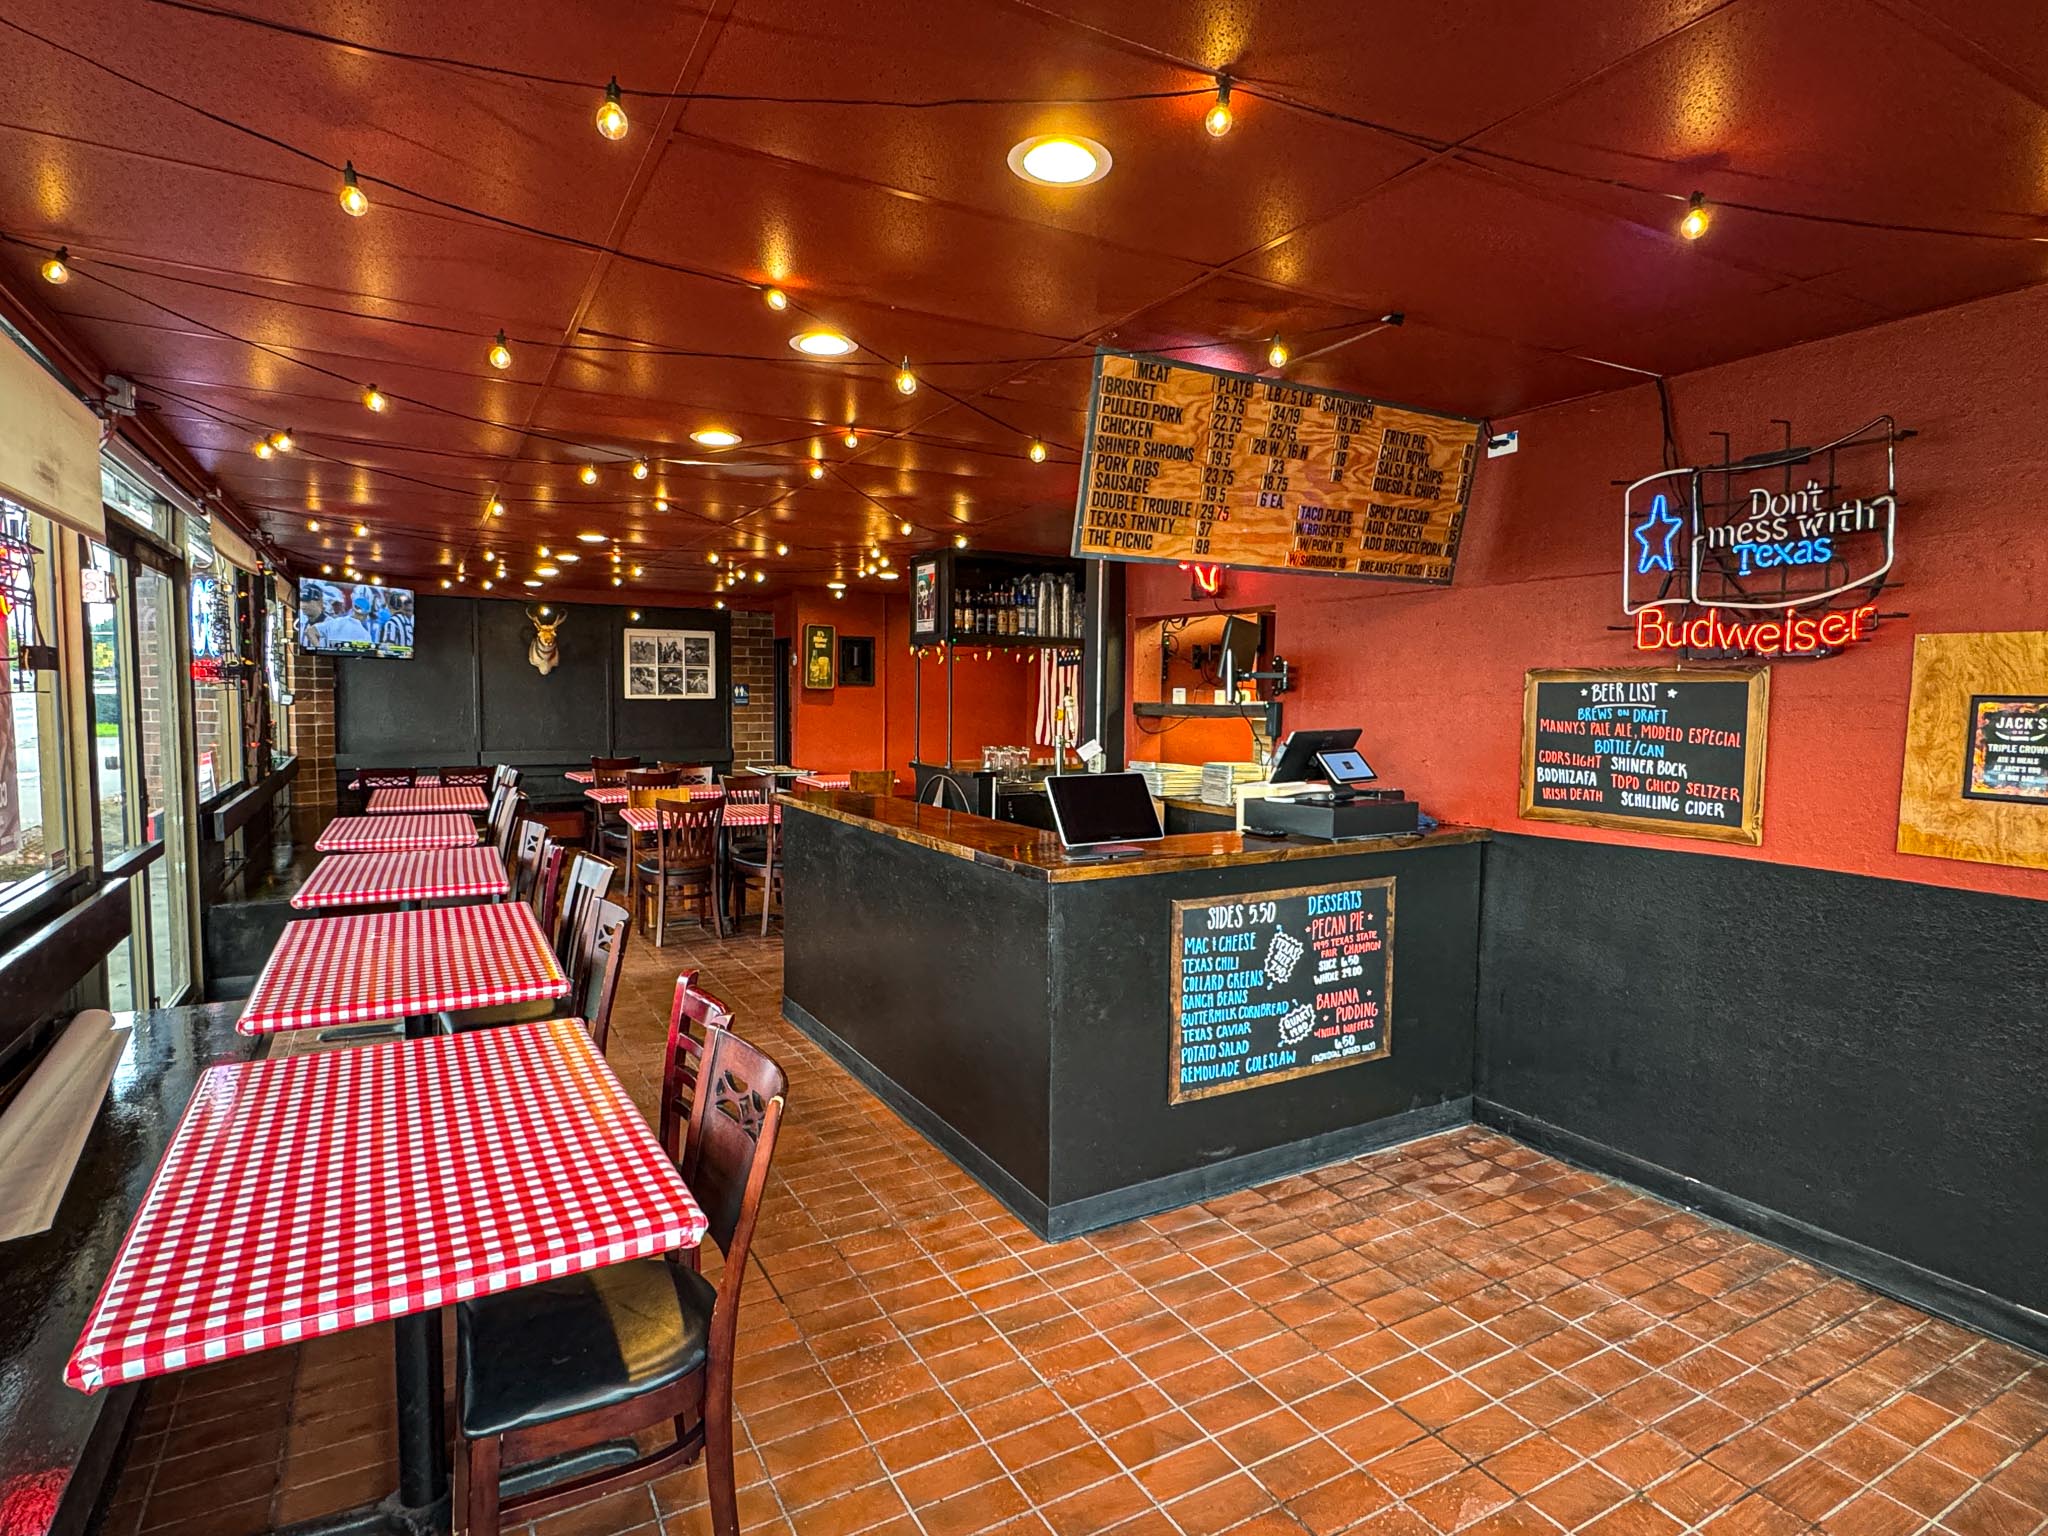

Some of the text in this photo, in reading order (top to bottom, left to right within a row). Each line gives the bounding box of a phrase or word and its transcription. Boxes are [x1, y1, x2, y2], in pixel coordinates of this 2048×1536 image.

[1138, 363, 1171, 383] MEAT
[1105, 376, 1157, 401] BRISKET
[1218, 377, 1254, 398] PLATE
[1102, 396, 1183, 423] PULLED PORK
[1216, 395, 1246, 415] 25.75
[1273, 405, 1300, 424] 34/19
[1323, 396, 1375, 420] SANDWICH
[1101, 415, 1154, 438] CHICKEN
[1213, 414, 1242, 433] 22.75
[1269, 423, 1297, 441] 25/15
[1337, 416, 1361, 434] 19.75
[1097, 435, 1195, 462] SHINER SHROOMS
[1213, 432, 1234, 449] 21.5
[1384, 429, 1427, 450] FRITO PIE
[1096, 454, 1160, 477] PORK RIBS
[1212, 451, 1231, 467] 19.5
[1272, 460, 1285, 474] 23
[1380, 445, 1430, 468] CHILI BOWL
[1095, 472, 1150, 494] SAUSAGE
[1205, 467, 1235, 485] 23.75
[1263, 475, 1289, 492] 18.75
[1377, 461, 1444, 485] SALSA & CHIPS
[1206, 486, 1226, 503] 19.5
[1374, 476, 1441, 501] QUESO & CHIPS
[1092, 491, 1192, 517] DOUBLE TROUBLE
[1750, 480, 1823, 520] Don't
[1090, 510, 1176, 534] TEXAS TRINITY
[1201, 504, 1230, 521] 29.75
[1300, 505, 1354, 524] TACO PLATE
[1369, 504, 1430, 524] SPICY CAESAR
[1199, 521, 1212, 537] 37
[1295, 522, 1342, 538] W/BRISKET
[1366, 520, 1424, 540] ADD CHICKEN
[1708, 499, 1875, 549] mess with
[1088, 529, 1153, 550] THE PICNIC
[1195, 539, 1210, 554] 98
[1300, 537, 1333, 553] W/PORK
[1363, 535, 1382, 550] ADD
[1289, 552, 1338, 569] W/SHROOMS
[1732, 537, 1832, 575] Texas
[1360, 560, 1403, 575] BREAKFAST
[1405, 564, 1422, 576] TACO
[1636, 604, 1877, 653] Budweiser
[1591, 682, 1659, 703] BEER LIST
[1577, 707, 1668, 725] BREWS ON DRAFT
[1995, 716, 2048, 731] JACK'S
[1540, 718, 1586, 736] MANNYS
[1590, 722, 1611, 737] PALE
[1641, 724, 1684, 742] MODELO
[1688, 727, 1741, 748] ESPECIAL
[1594, 739, 1665, 758] BOTTLE/CAN
[1987, 743, 2018, 753] TRIPLE
[1539, 750, 1602, 769] COORS LIGHT
[1610, 756, 1687, 780] SHINER BOCK
[1537, 767, 1597, 787] BODHIZAFA
[1542, 787, 1603, 803] IRISH DEATH
[1610, 774, 1740, 803] TOPO CHICO SELTZER
[1620, 791, 1725, 818] SCHILLING CIDER
[1308, 890, 1362, 916] DESSERTS
[1207, 901, 1277, 930] SIDES 5.50
[1312, 911, 1365, 940] PECAN PIE
[1184, 937, 1210, 955] MAC
[1218, 932, 1257, 952] CHEESE
[1331, 934, 1354, 947] TEXAS
[1356, 930, 1378, 942] STATE
[1321, 940, 1381, 959] FAIR CHAMPION
[1182, 956, 1239, 974] TEXAS CHILI
[1182, 969, 1264, 993] COLLARD GREENS
[1182, 989, 1248, 1010] RANCH BEANS
[1316, 987, 1360, 1011] BANANA
[1181, 1000, 1289, 1028] BUTTERMILK CORNBREAD
[1336, 1001, 1379, 1023] PUDDING
[1182, 1021, 1252, 1043] TEXAS CAVIAR
[1181, 1040, 1249, 1065] POTATO SALAD
[1181, 1060, 1240, 1084] REMOULADE
[1245, 1050, 1297, 1073] COLESLAW
